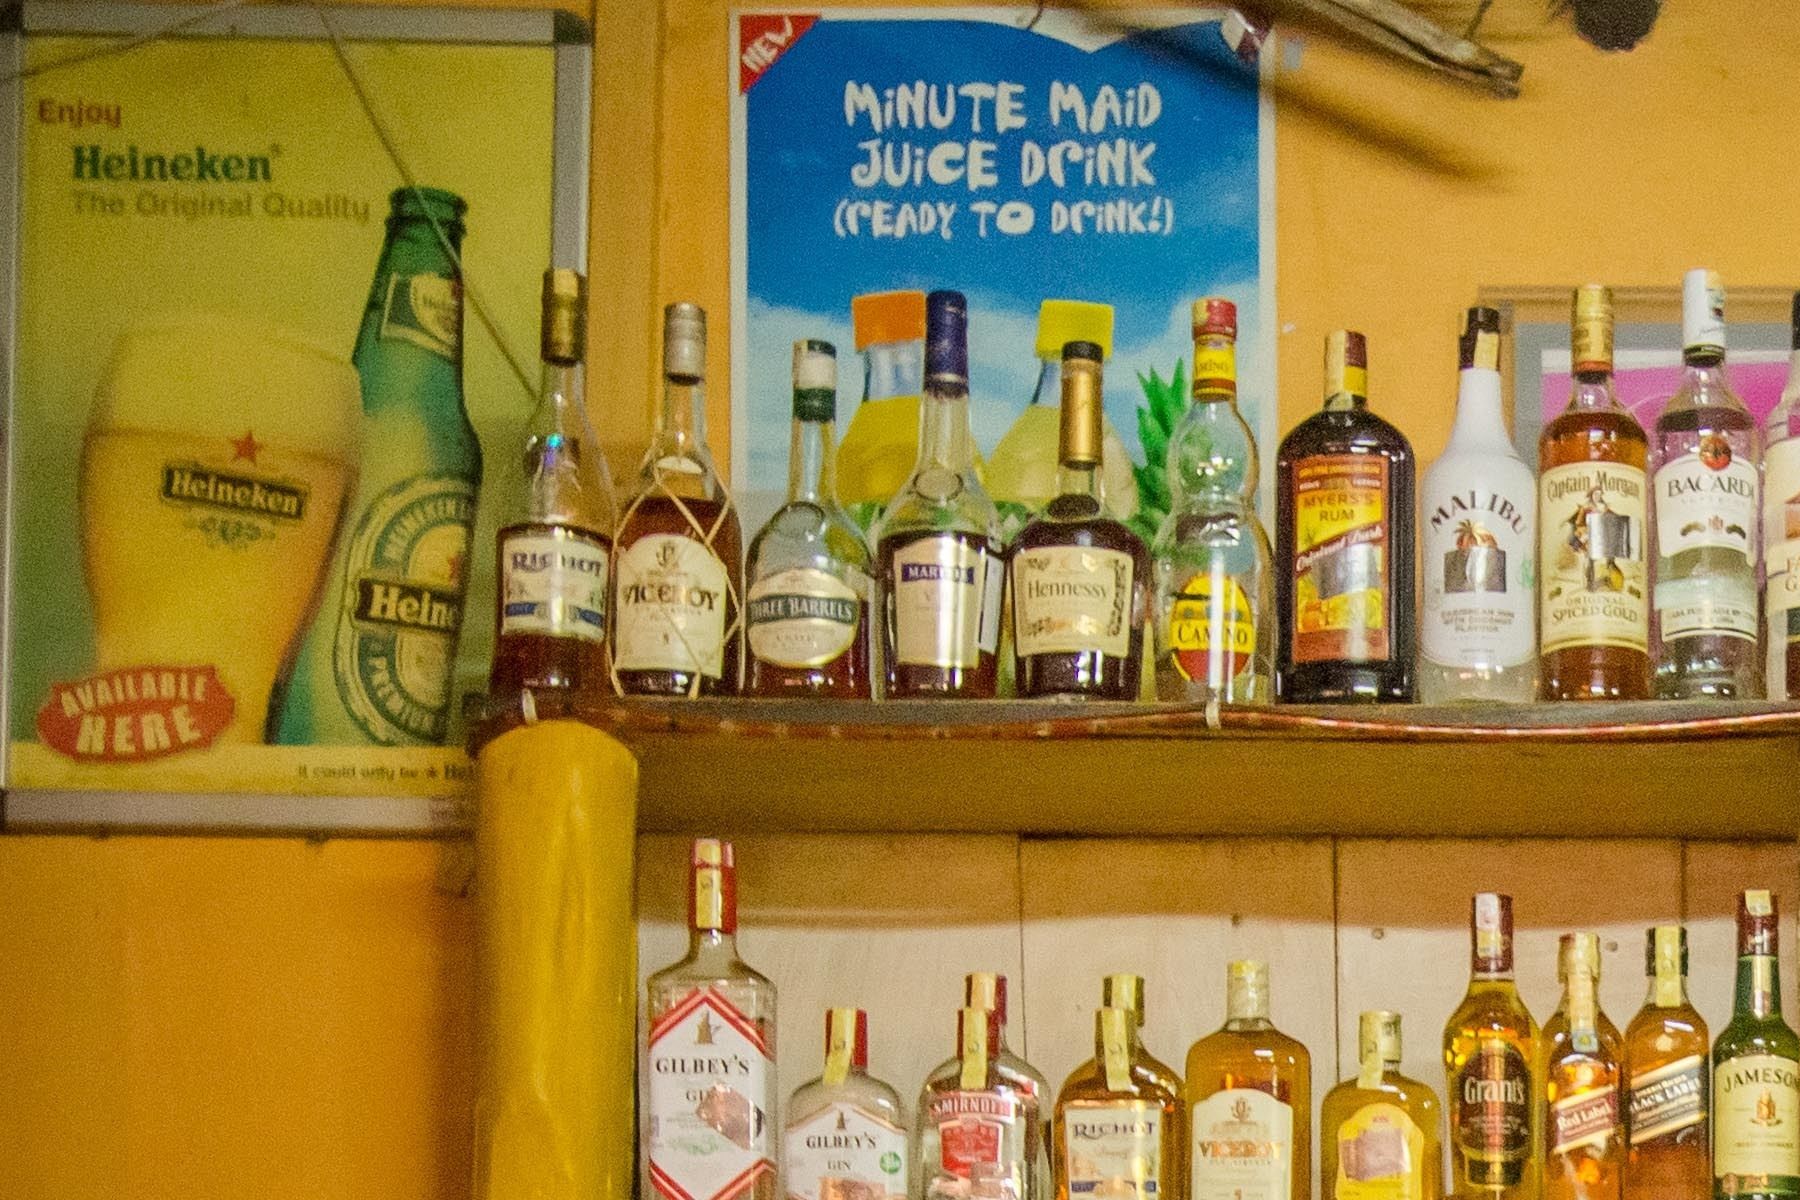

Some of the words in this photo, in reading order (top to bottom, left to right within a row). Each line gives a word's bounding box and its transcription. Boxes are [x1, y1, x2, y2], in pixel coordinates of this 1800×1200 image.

[741, 16, 794, 74] NEW
[37, 99, 122, 128] Enjoy
[71, 145, 273, 183] Heineken
[74, 192, 126, 217] The
[134, 192, 253, 224] Original
[262, 193, 371, 225] Quality
[970, 201, 1035, 237] TO
[170, 469, 300, 514] Heineken
[1596, 470, 1641, 501] Morgan
[1318, 507, 1356, 523] RUM
[1430, 490, 1527, 535] MALIBU
[620, 582, 721, 612] VICEOY
[1027, 579, 1109, 601] Hennessy
[60, 672, 210, 719] AVAILABLE
[76, 706, 202, 756] HERE
[655, 1054, 751, 1075] GILBEY'S
[1464, 1075, 1526, 1106] Grant's
[1581, 1101, 1612, 1127] Label
[805, 1131, 879, 1150] GILBEY'S
[1073, 1120, 1156, 1142] RICHOT
[826, 1158, 852, 1172] GIN
